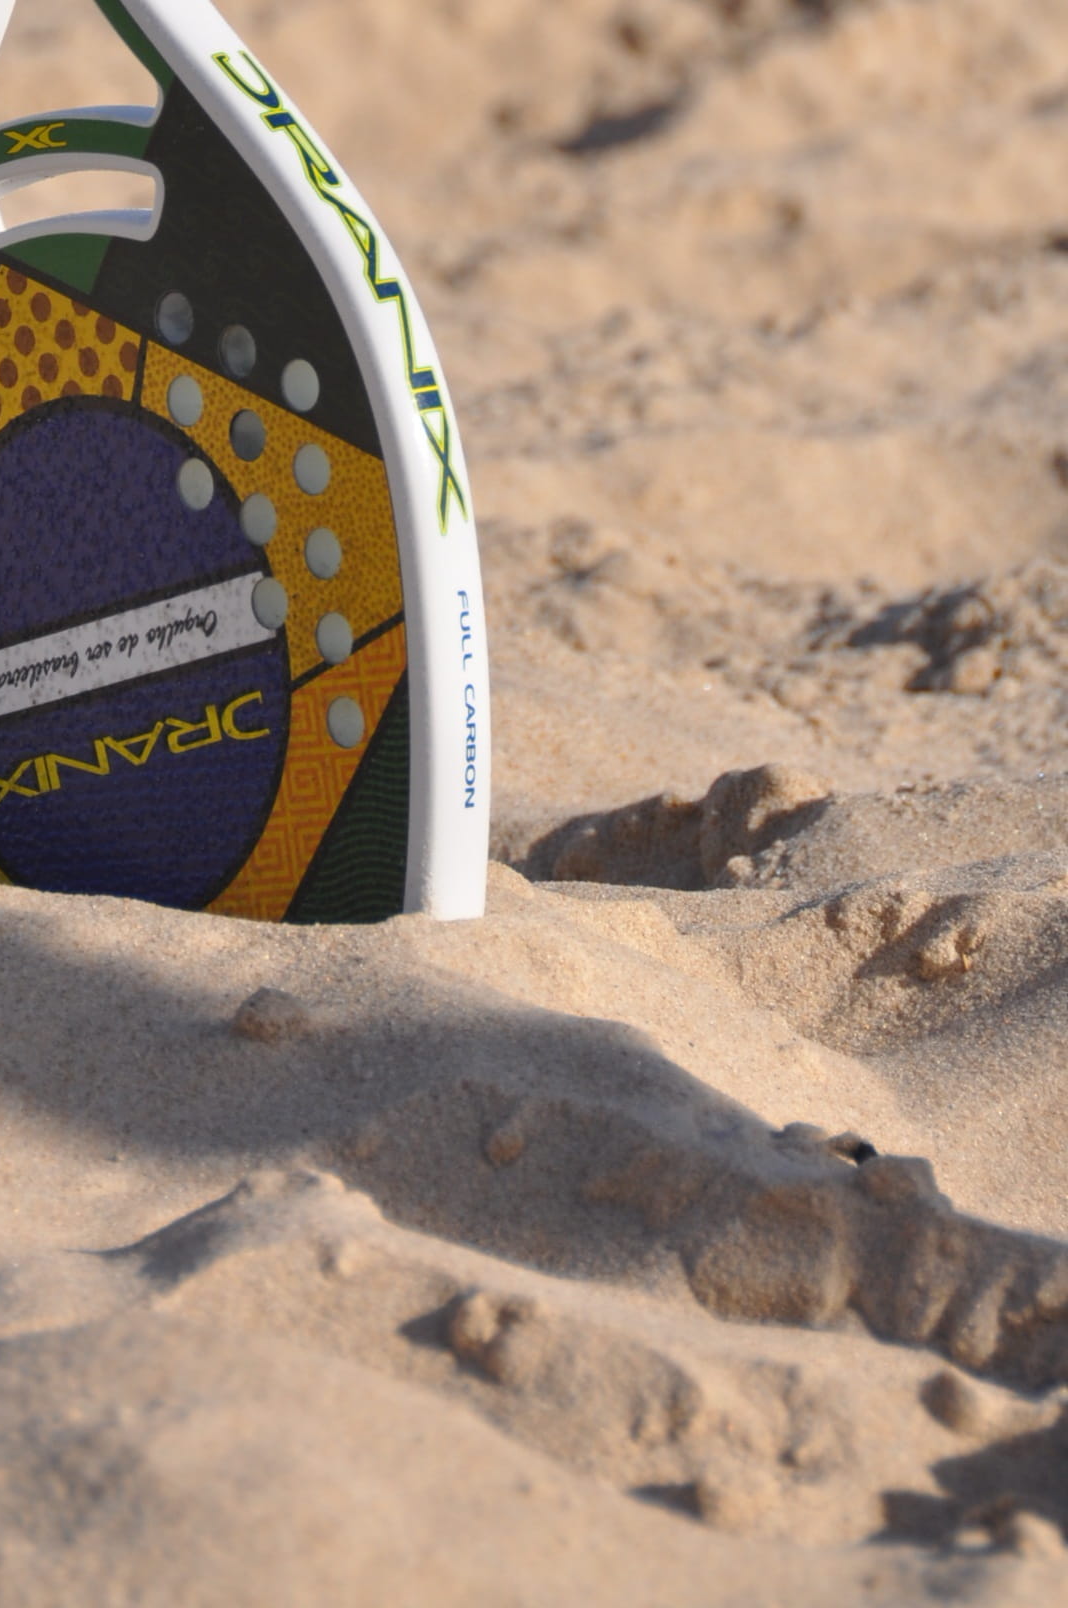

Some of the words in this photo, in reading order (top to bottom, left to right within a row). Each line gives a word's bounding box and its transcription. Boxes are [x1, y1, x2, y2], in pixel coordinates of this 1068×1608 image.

[119, 631, 141, 657] de
[145, 609, 219, 651] Orgulho
[456, 590, 473, 672] FULL
[85, 642, 114, 663] ser
[463, 683, 477, 809] CARBON
